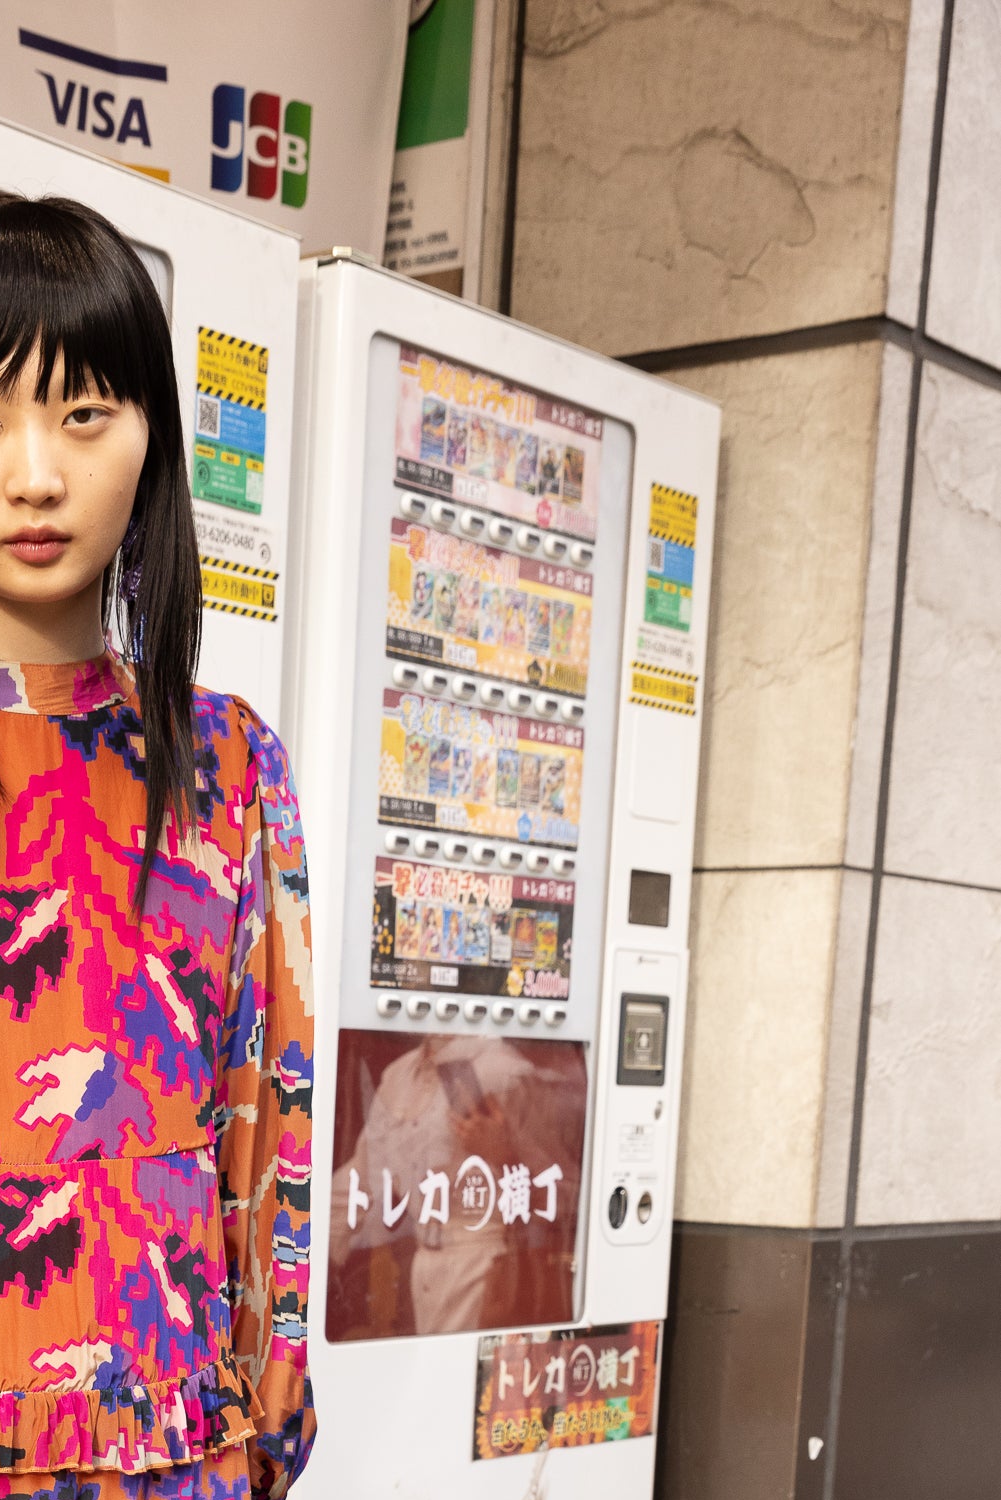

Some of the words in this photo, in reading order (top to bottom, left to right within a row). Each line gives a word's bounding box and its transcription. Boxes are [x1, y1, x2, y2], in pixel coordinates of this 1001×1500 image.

[35, 68, 152, 149] VISA
[347, 1166, 450, 1230] トレカ
[497, 1163, 564, 1225] 横丁
[498, 1355, 567, 1400] トレカ
[596, 1345, 640, 1391] 横丁
